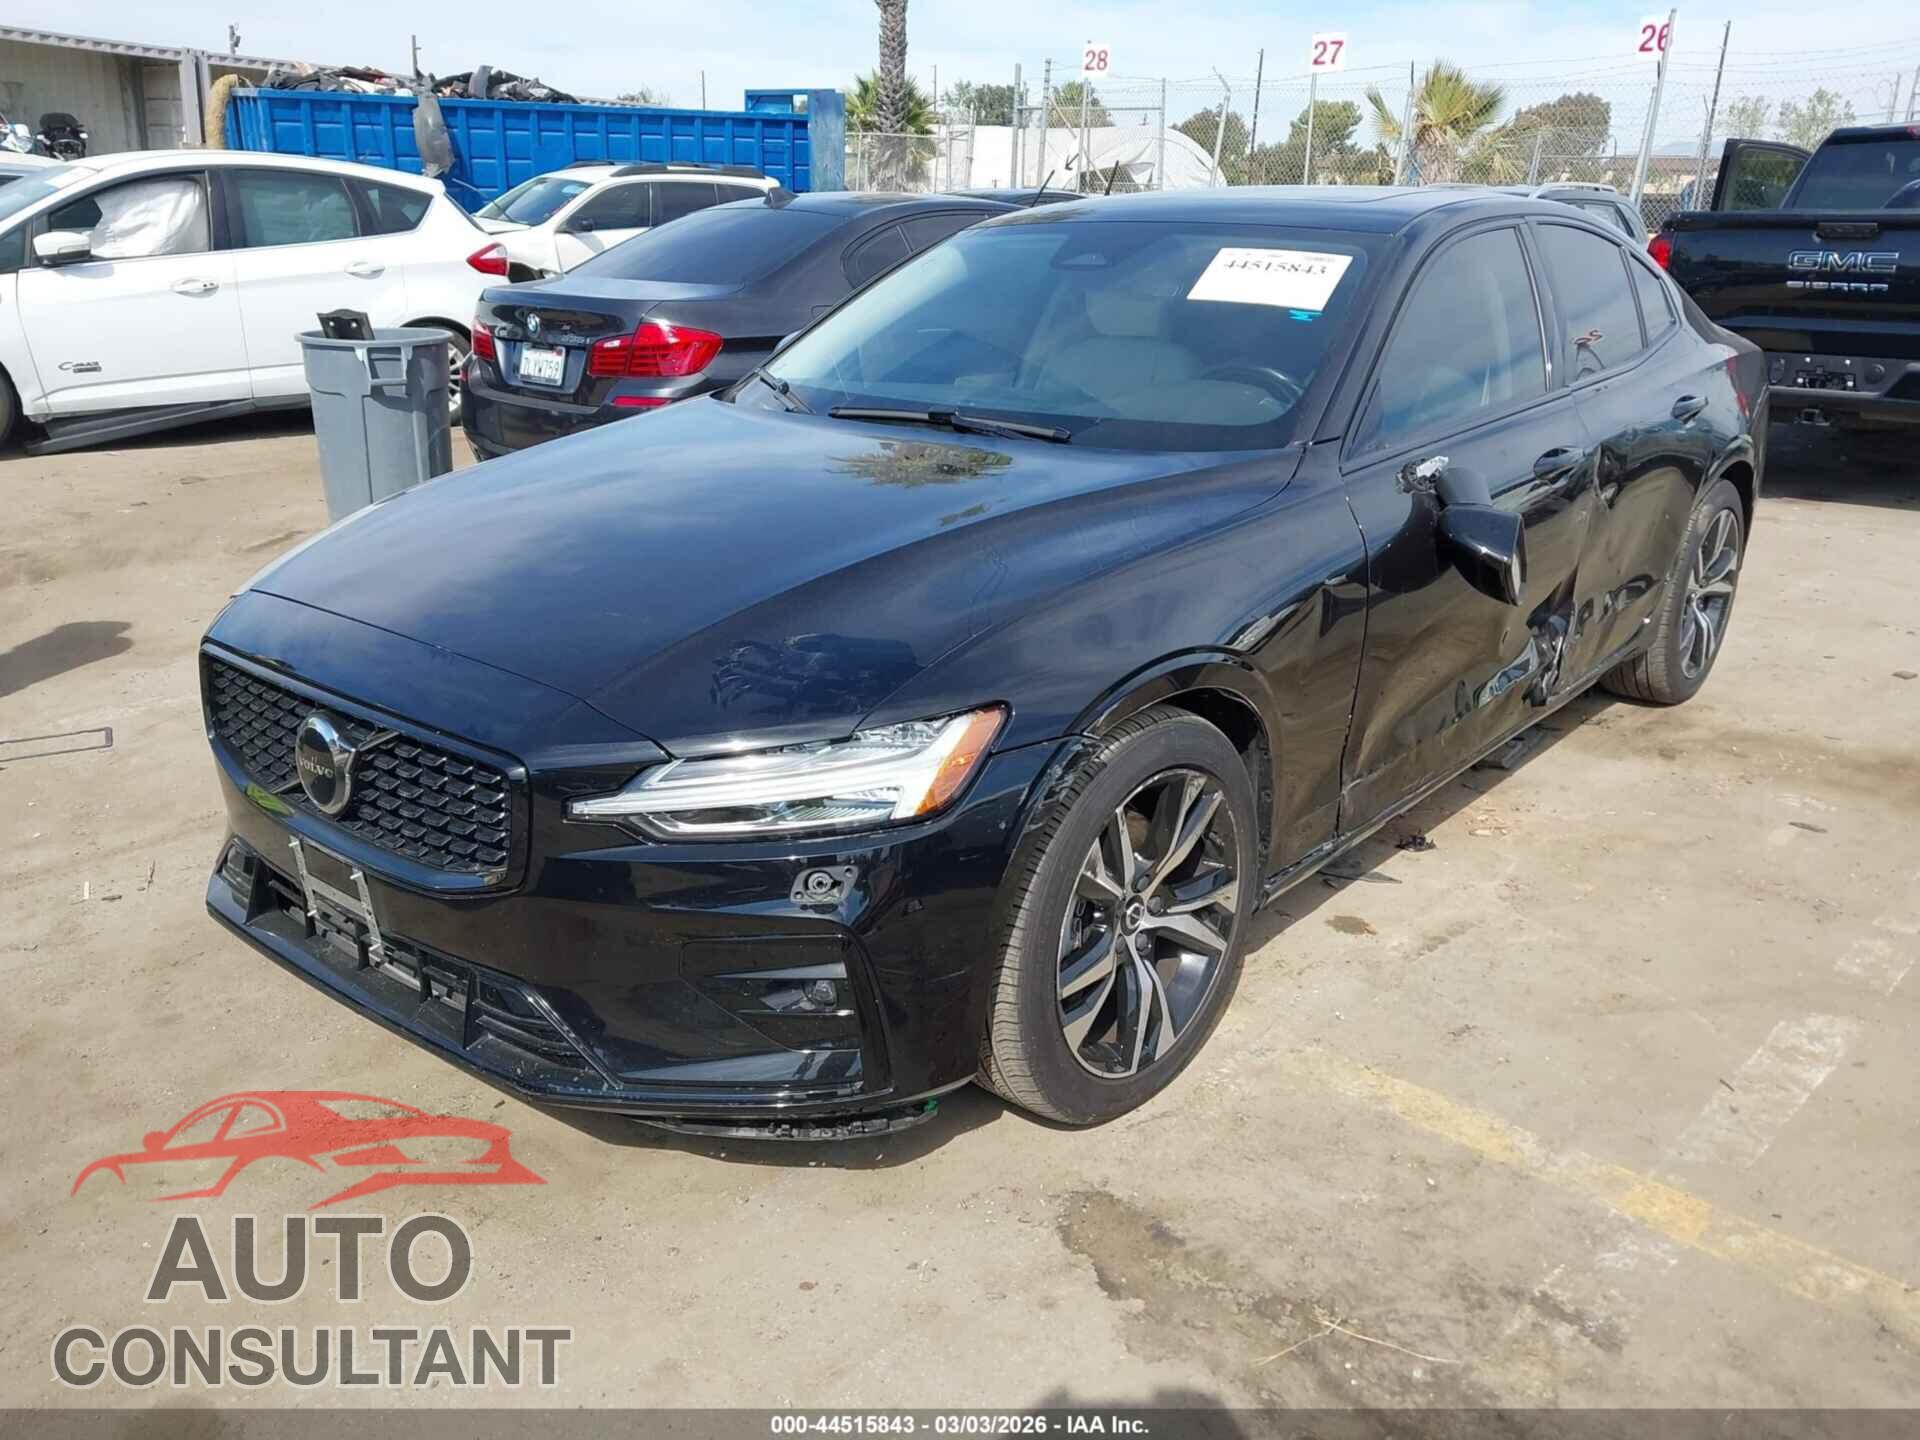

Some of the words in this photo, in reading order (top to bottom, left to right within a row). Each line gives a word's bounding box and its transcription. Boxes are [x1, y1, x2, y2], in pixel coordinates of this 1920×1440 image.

[1084, 50, 1108, 71] 28
[1312, 40, 1344, 65] 27
[1224, 260, 1328, 275] 44515843
[1787, 250, 1900, 273] GMC
[300, 758, 334, 779] VOLVO
